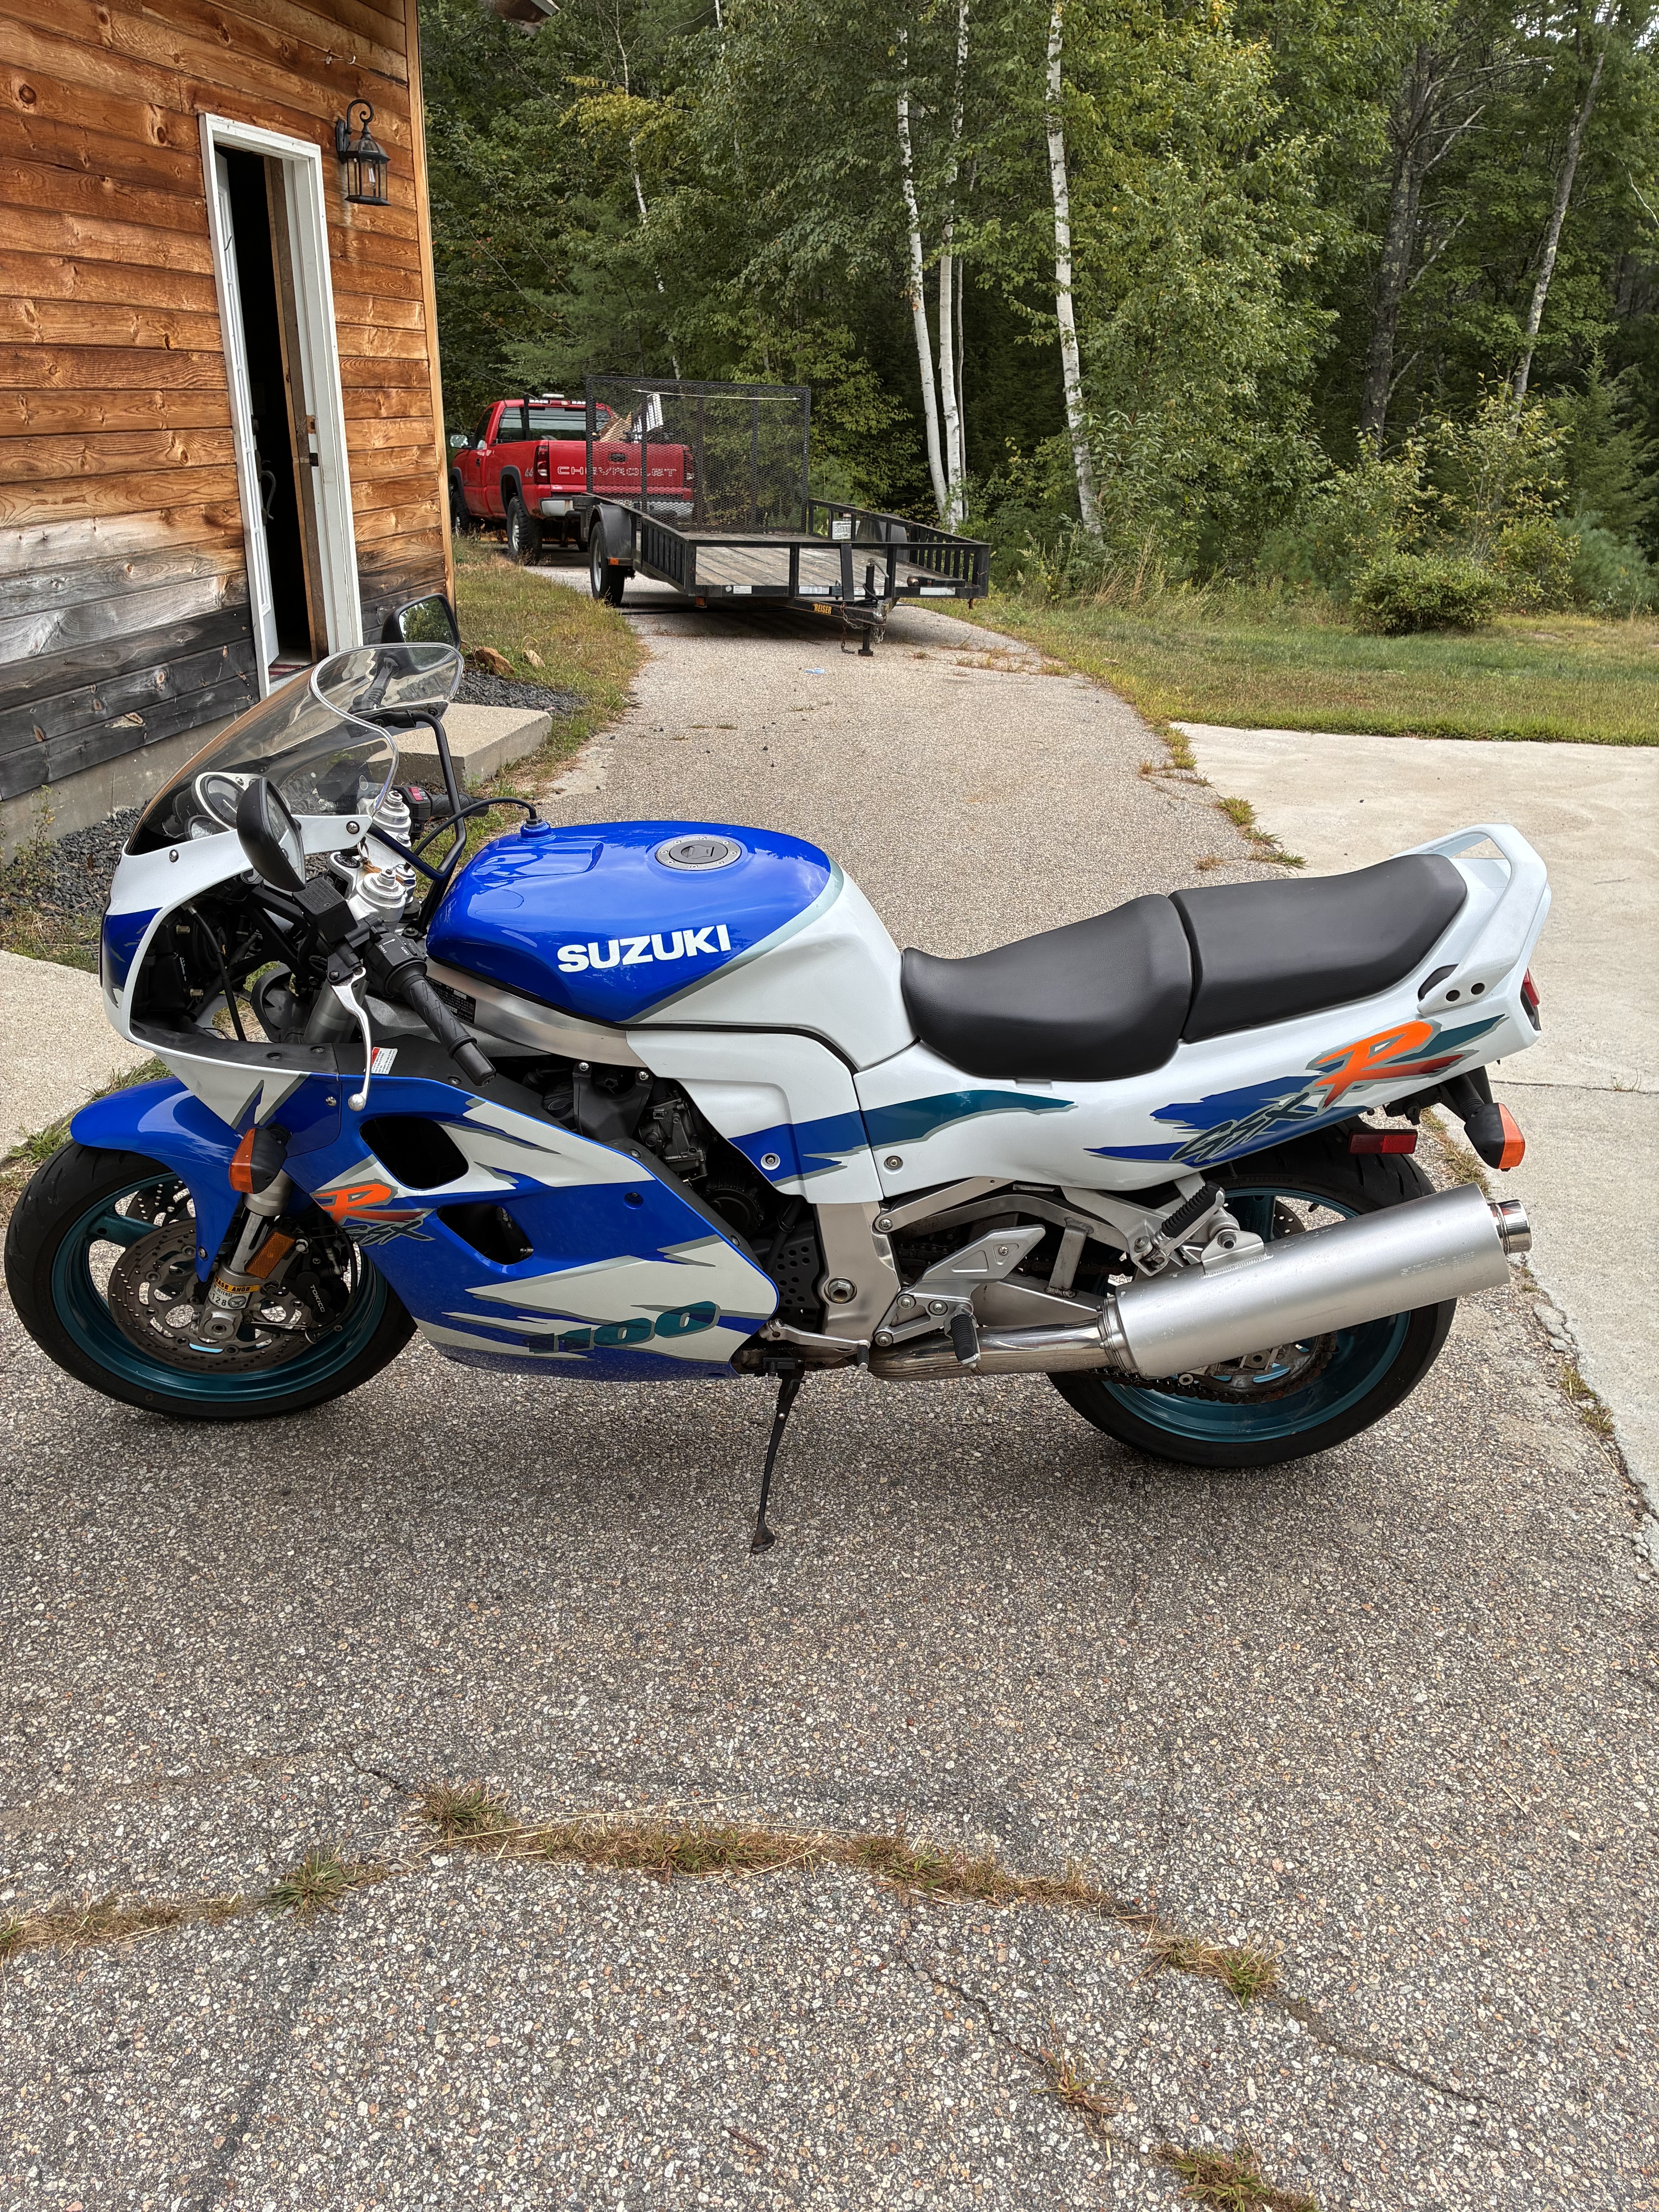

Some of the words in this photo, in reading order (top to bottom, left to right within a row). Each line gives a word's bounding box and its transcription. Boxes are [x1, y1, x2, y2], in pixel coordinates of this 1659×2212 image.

[557, 466, 677, 477] CHEVROET
[814, 603, 832, 615] REISER
[557, 924, 732, 972] SUZUKI
[311, 1182, 427, 1224] R
[310, 1284, 325, 1312] TOKICO
